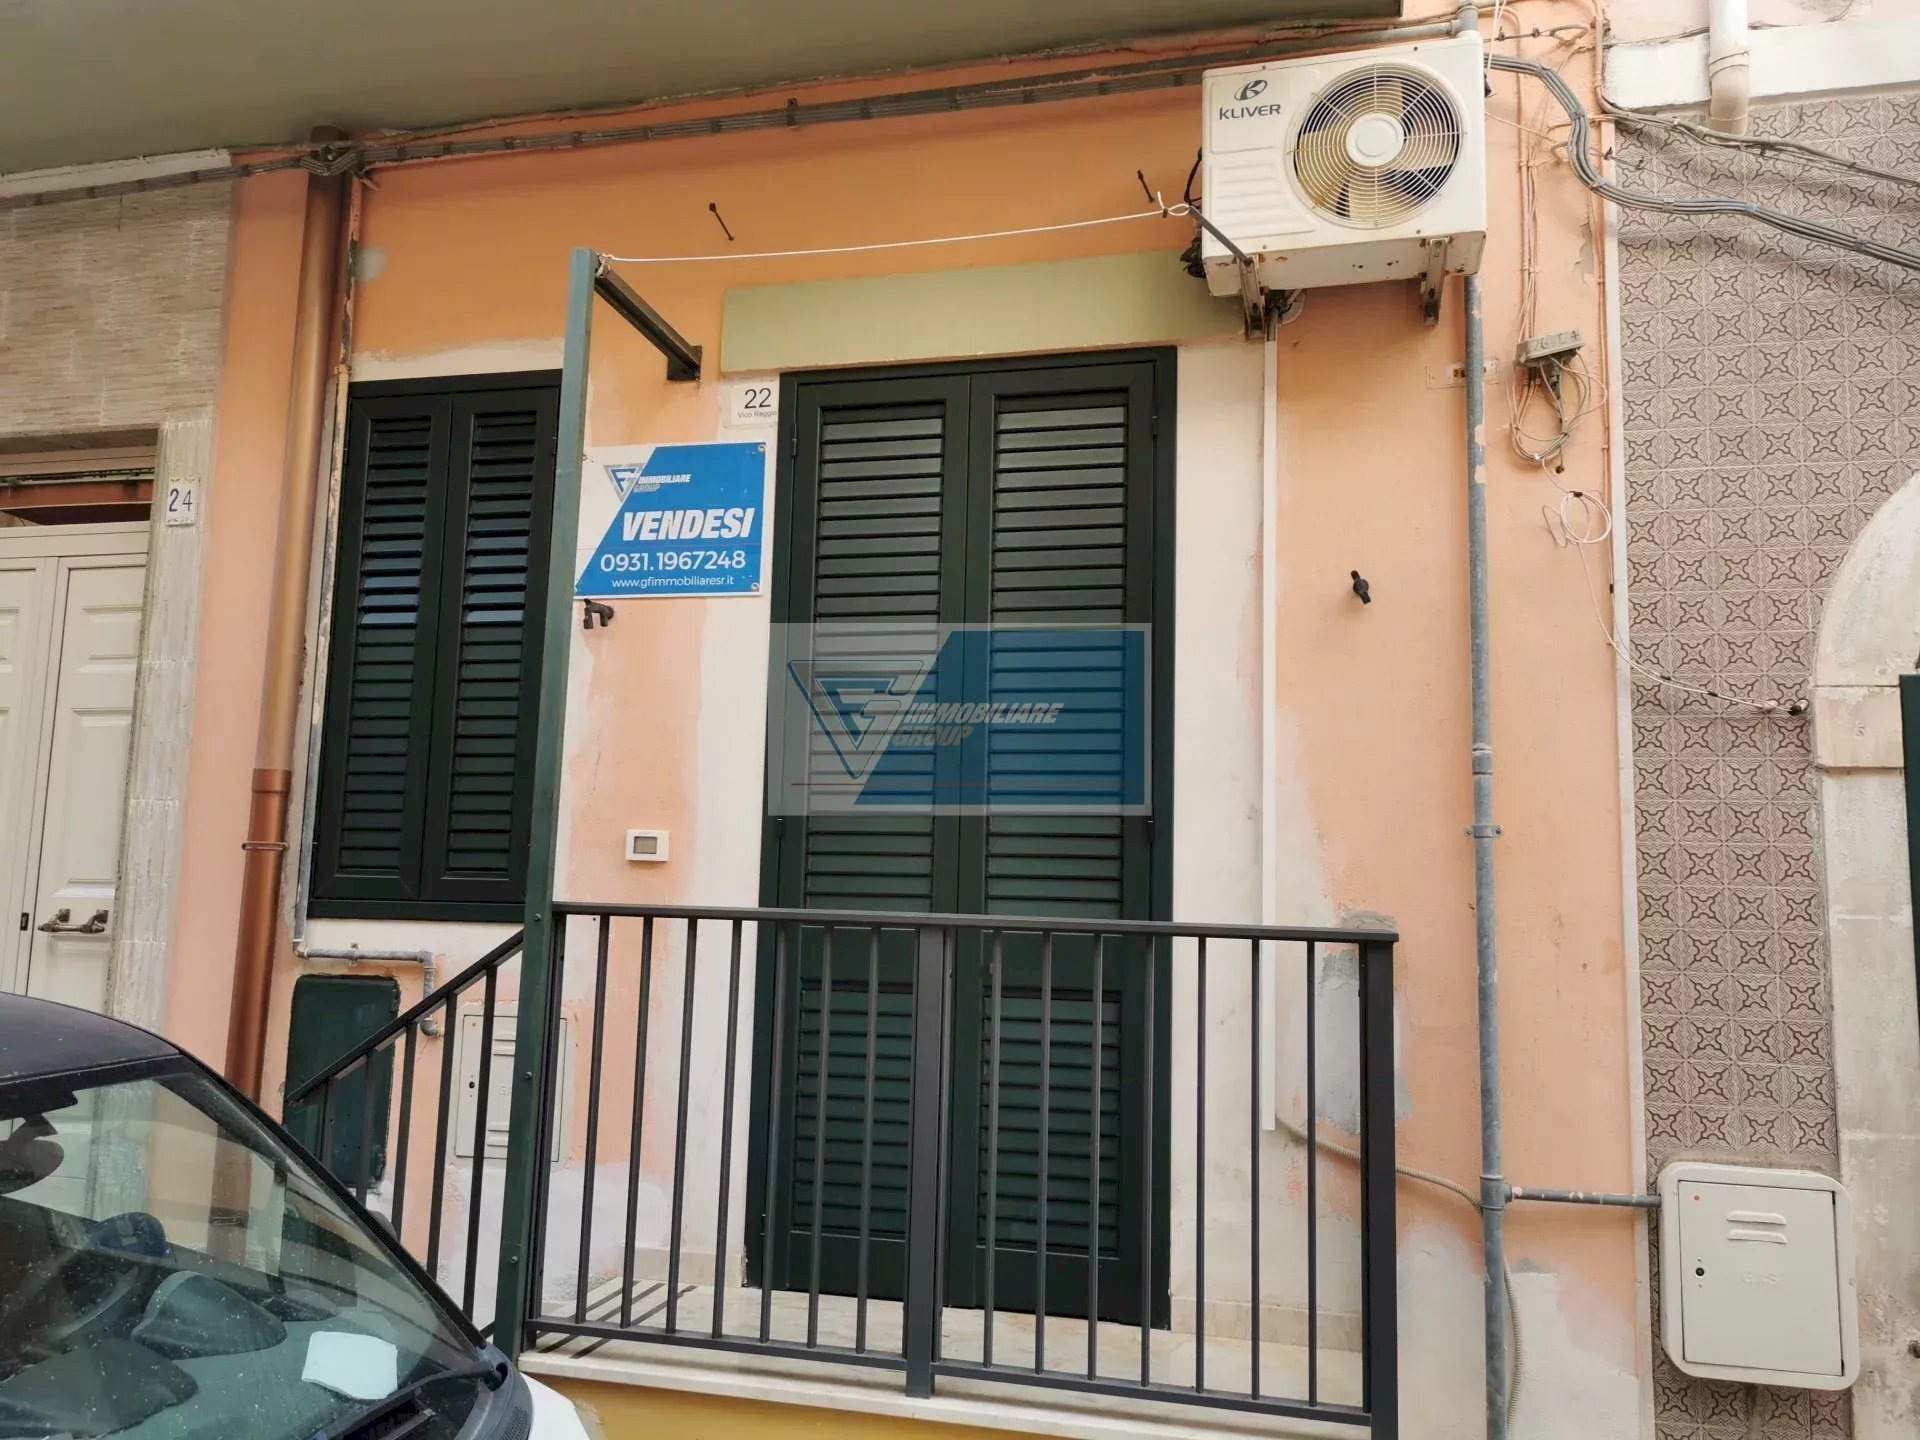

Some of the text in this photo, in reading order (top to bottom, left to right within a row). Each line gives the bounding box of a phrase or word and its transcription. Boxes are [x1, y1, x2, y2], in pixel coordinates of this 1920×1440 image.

[1219, 104, 1281, 120] KLIVER
[744, 387, 772, 409] 22
[638, 474, 692, 485] IMMOBILIARE
[169, 488, 193, 512] 24
[622, 507, 756, 541] VENDESI
[600, 550, 746, 572] 0931.1967248
[611, 574, 735, 589] www.gfimmobiliaresr.it
